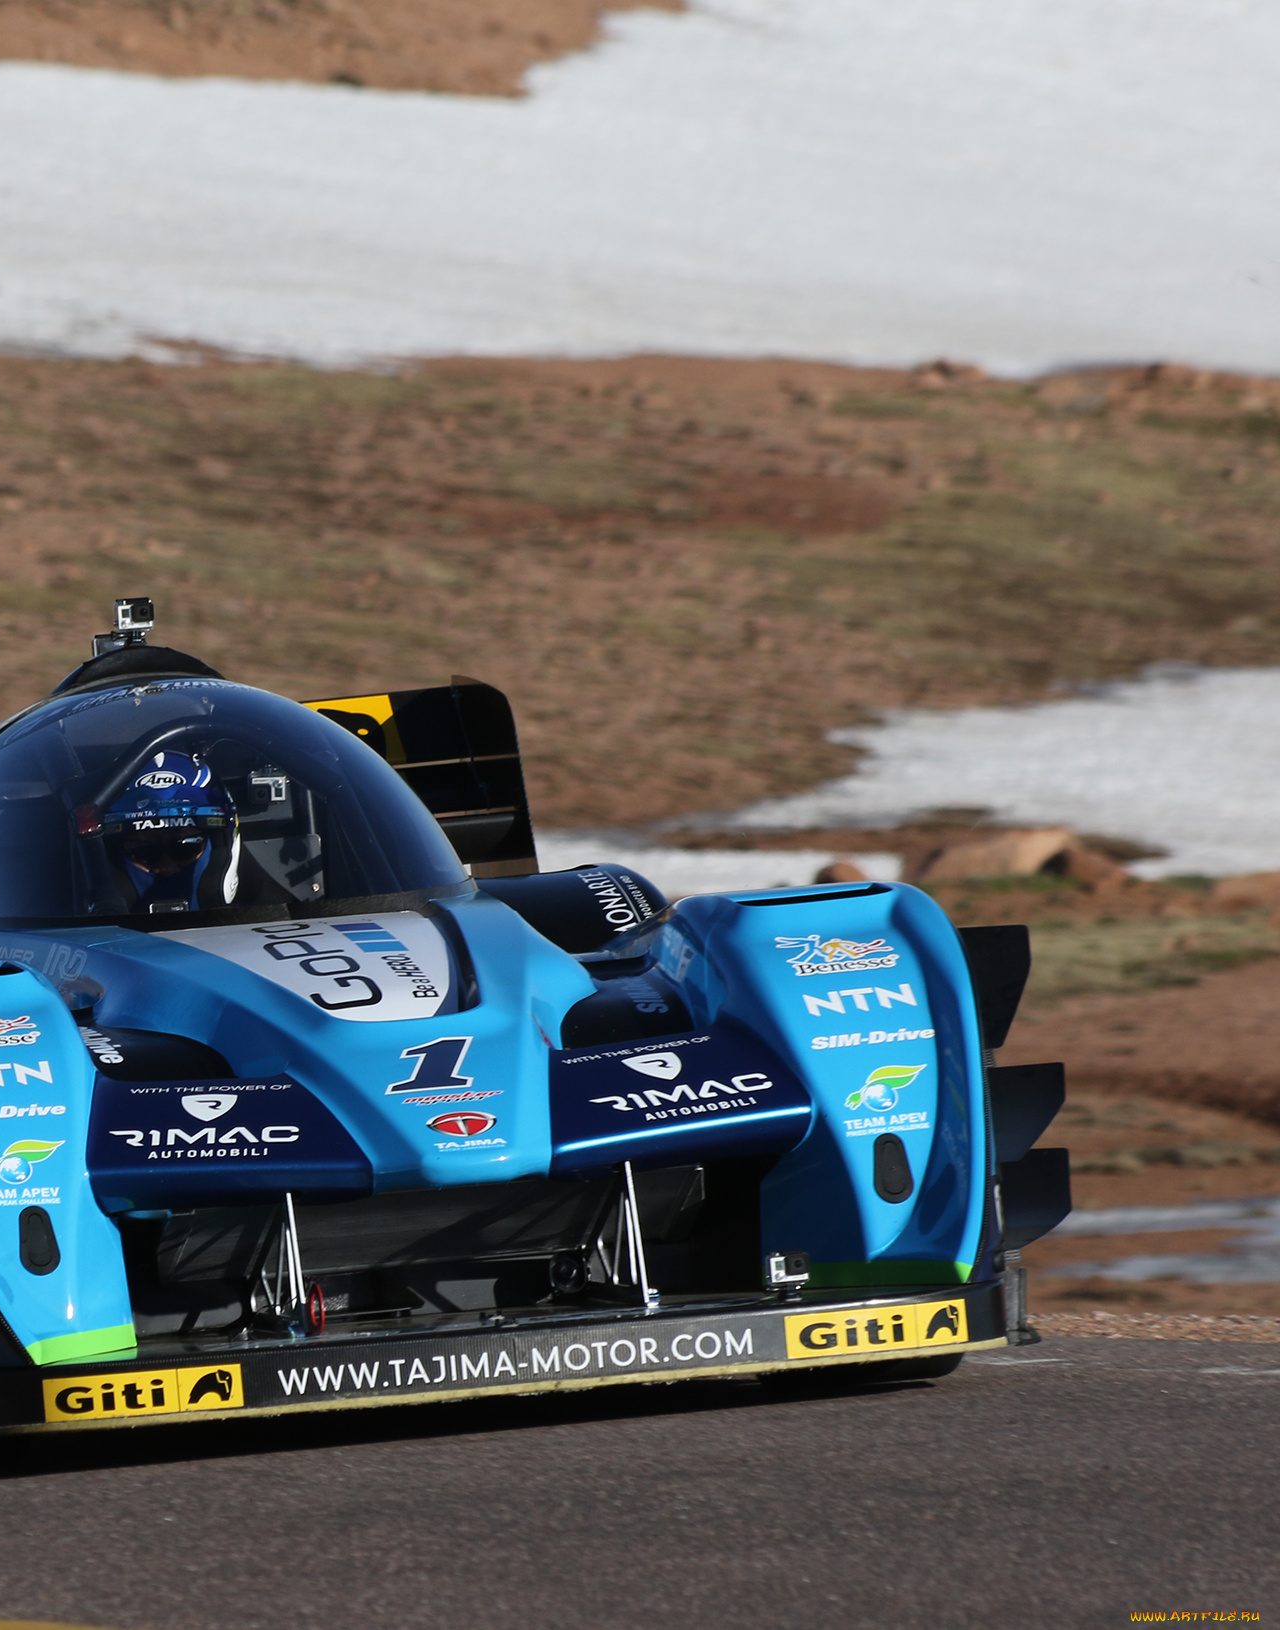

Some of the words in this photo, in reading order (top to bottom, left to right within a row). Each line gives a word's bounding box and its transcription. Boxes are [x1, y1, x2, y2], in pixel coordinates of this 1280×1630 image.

[146, 774, 179, 785] Arai
[133, 818, 196, 830] TAJIMA
[797, 957, 892, 976] Benesse
[803, 983, 917, 1016] NTN
[562, 1054, 601, 1064] WITH
[602, 1048, 634, 1058] THE
[634, 1040, 690, 1053] POWER
[694, 1035, 712, 1044] OF
[811, 1028, 935, 1050] SIM-Drive
[385, 1036, 474, 1095] 1
[588, 1073, 773, 1112] RIMAC
[645, 1097, 757, 1121] AUTOMOBILI
[843, 1116, 886, 1130] TEAM
[890, 1112, 927, 1125] APEV
[109, 1126, 300, 1147] RIMAC
[433, 1138, 507, 1149] TAJIMA
[148, 1147, 268, 1160] AUTOMOBILI
[21, 1187, 60, 1198] APEV
[799, 1313, 903, 1351] Giti
[277, 1328, 754, 1396] WWW.TAJIMA-MOTOR.COM
[55, 1379, 166, 1415] Giti
